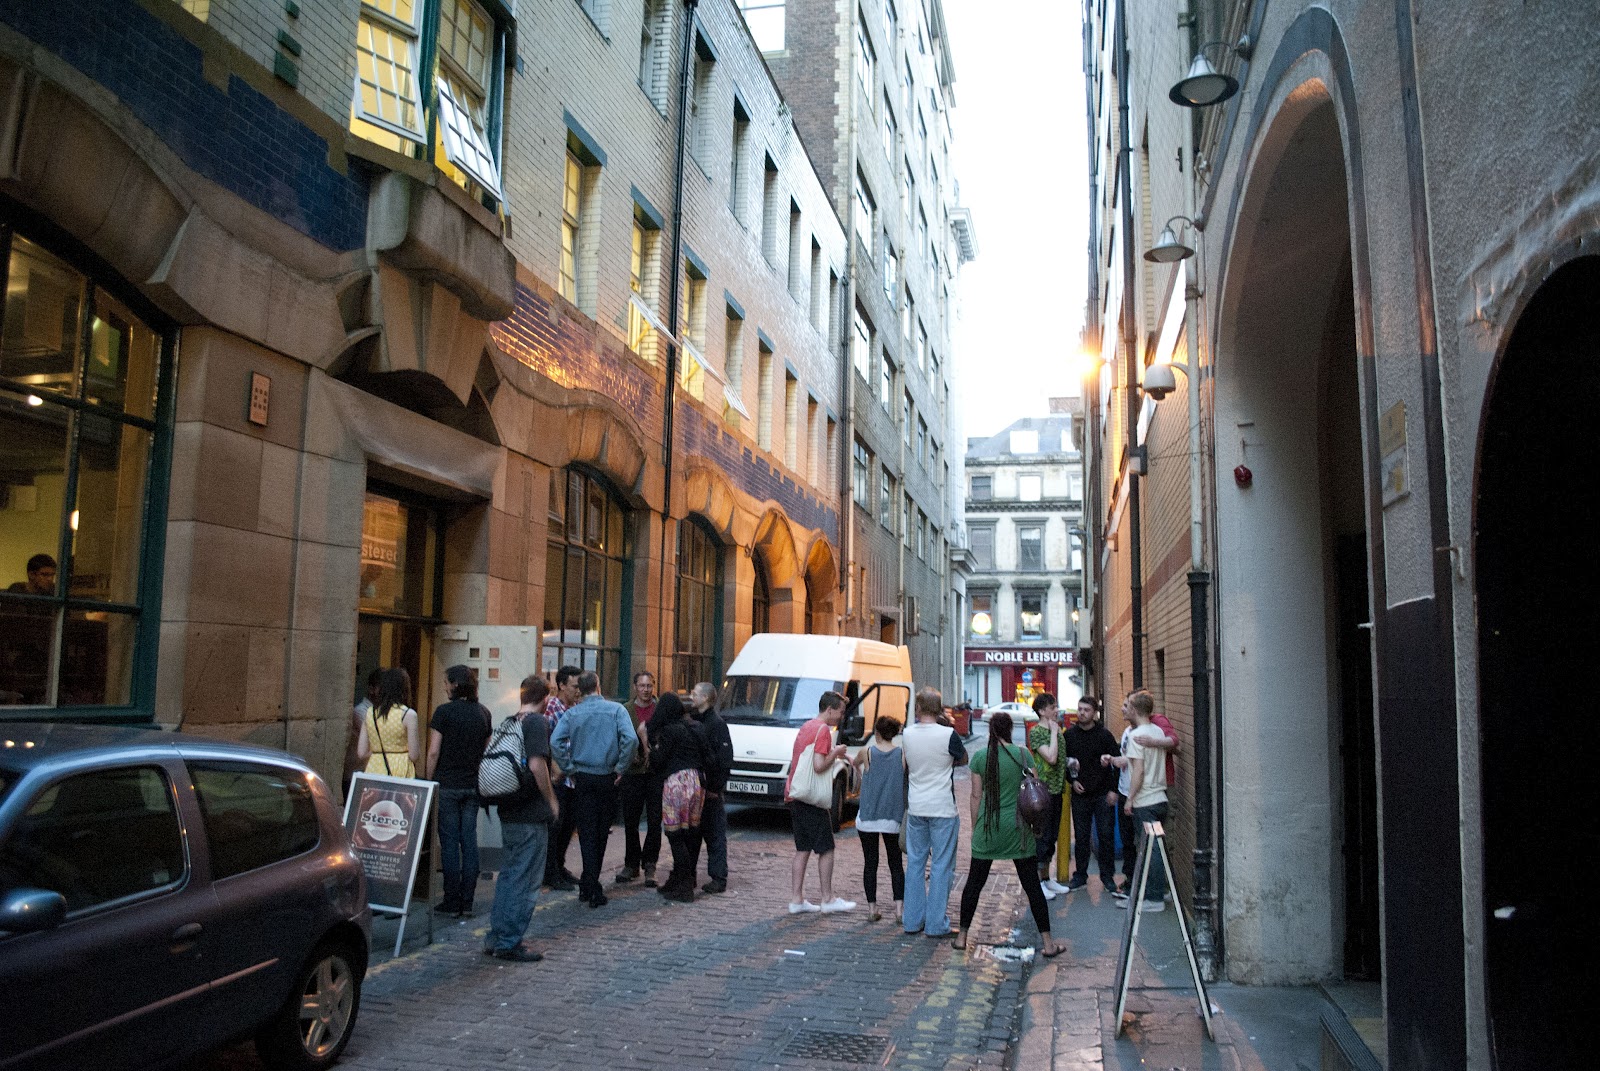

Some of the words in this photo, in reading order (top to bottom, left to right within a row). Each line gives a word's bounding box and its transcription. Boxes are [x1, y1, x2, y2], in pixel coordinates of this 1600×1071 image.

[985, 652, 1024, 662] NOBLE
[1026, 652, 1073, 662] LEISURE
[729, 782, 748, 790] BK06
[361, 811, 408, 829] Stereo
